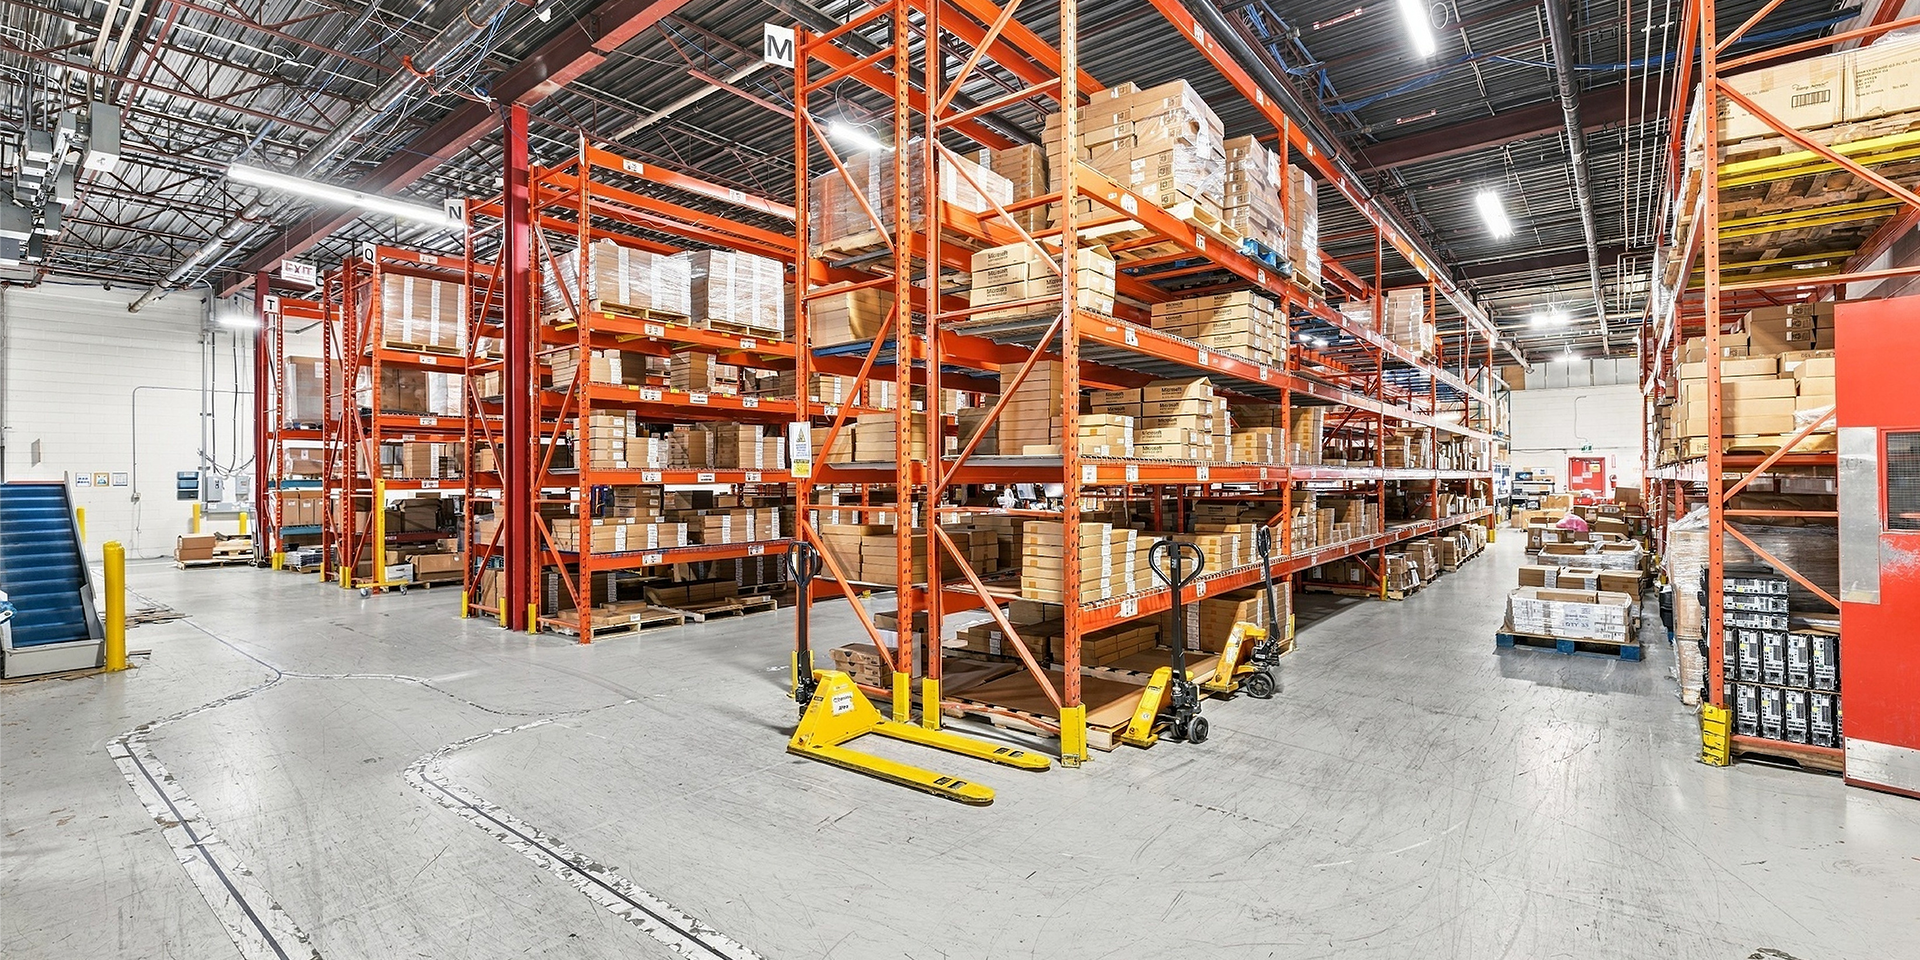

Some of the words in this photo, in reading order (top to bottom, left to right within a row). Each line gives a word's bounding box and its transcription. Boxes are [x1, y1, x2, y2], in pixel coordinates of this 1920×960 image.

[767, 34, 792, 62] M
[449, 206, 461, 219] N
[365, 248, 374, 263] Q
[286, 262, 313, 274] EXIT
[267, 300, 275, 310] T
